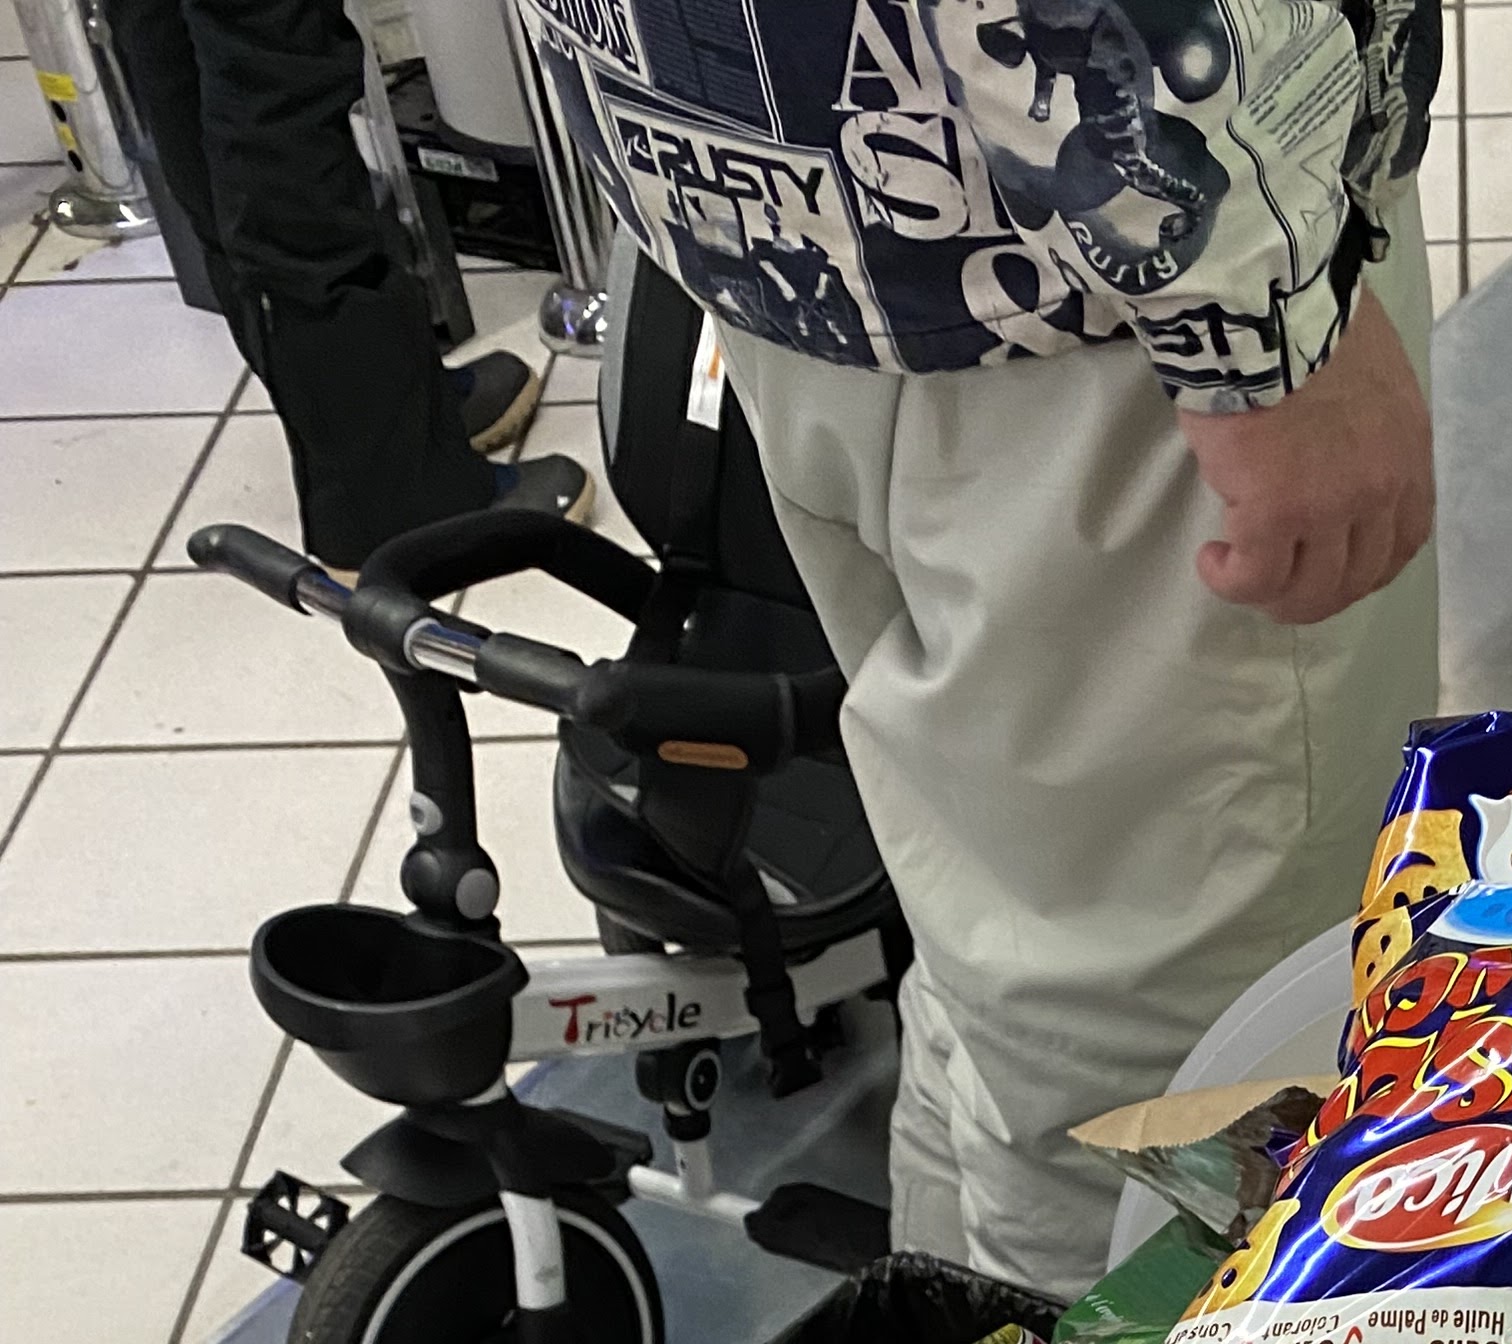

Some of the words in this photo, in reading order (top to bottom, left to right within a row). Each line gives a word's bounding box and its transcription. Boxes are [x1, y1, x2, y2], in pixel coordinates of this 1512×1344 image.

[650, 127, 823, 216] RUSTY
[549, 993, 700, 1044] Tricycle
[1368, 1309, 1427, 1335] Palme
[1431, 1308, 1448, 1324] de
[1453, 1308, 1505, 1336] Huile
